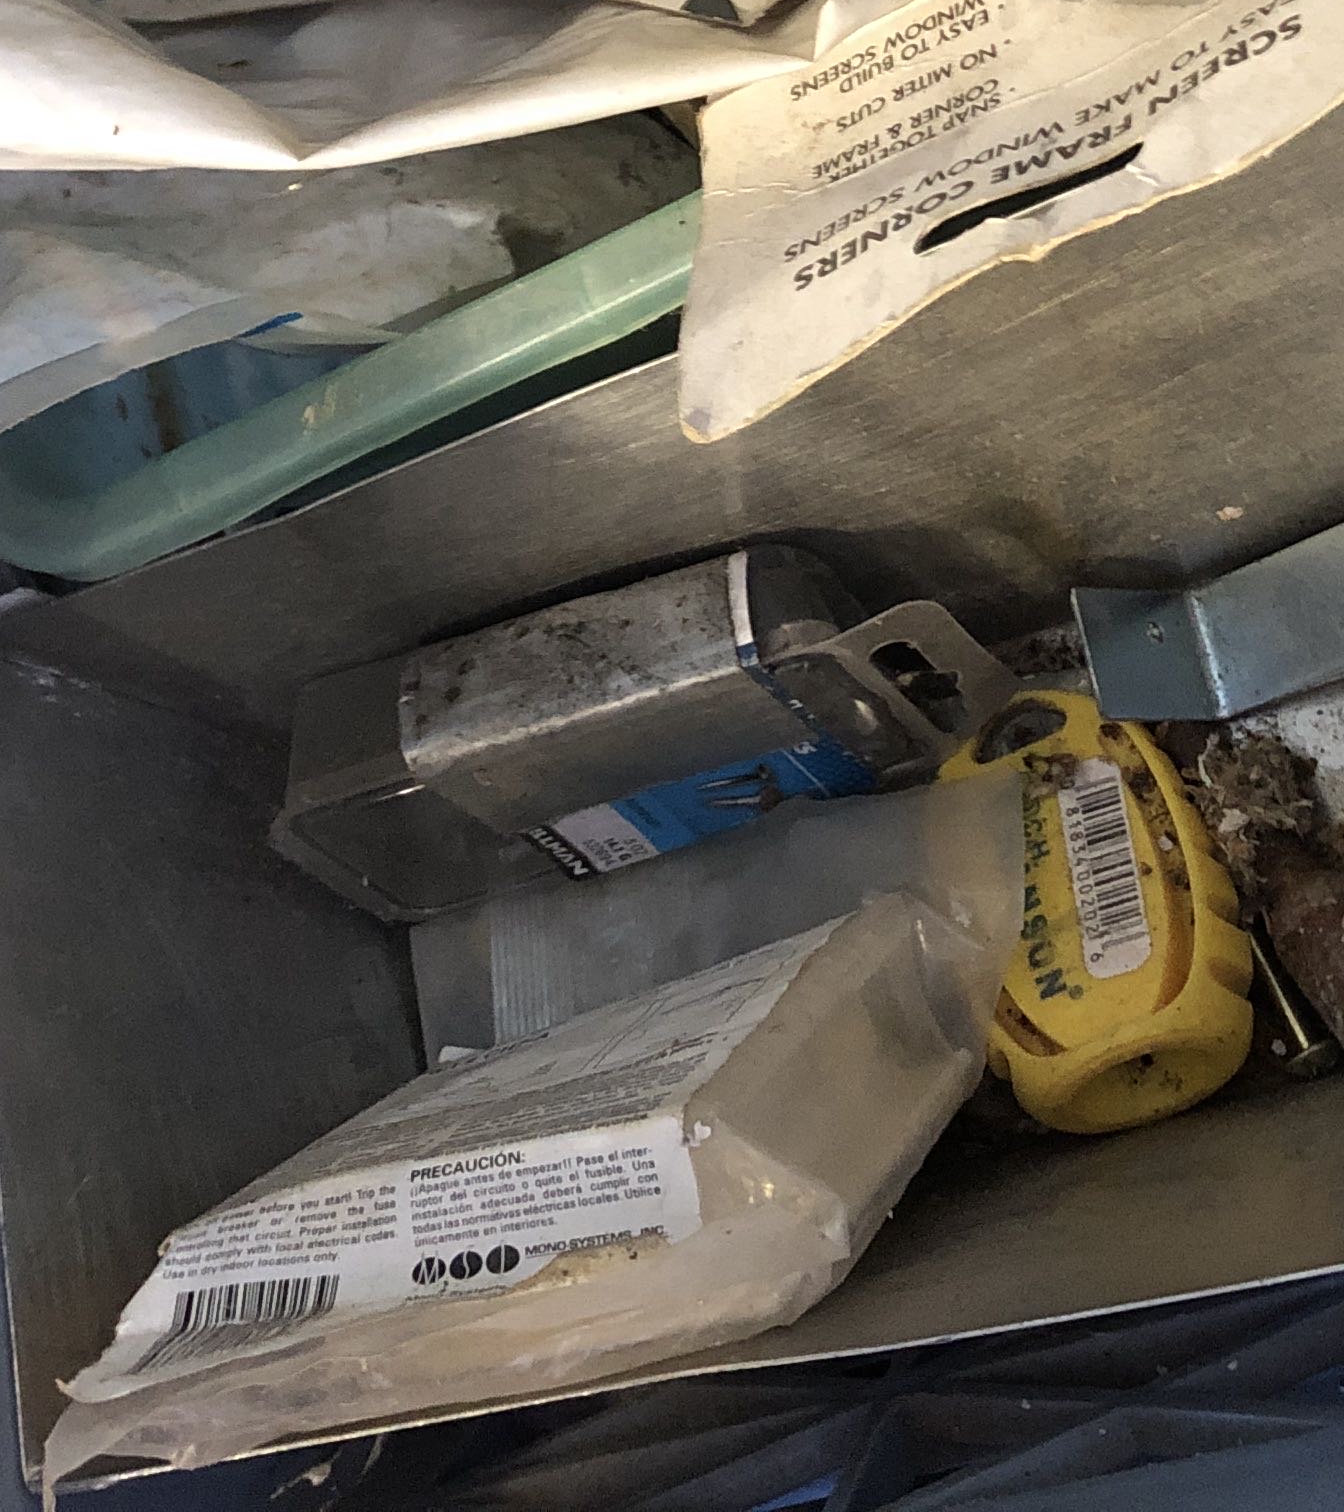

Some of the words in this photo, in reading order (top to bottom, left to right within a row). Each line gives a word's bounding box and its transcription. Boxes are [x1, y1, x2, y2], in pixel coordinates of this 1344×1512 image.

[935, 8, 990, 46] EASY
[900, 37, 931, 61] TO
[959, 43, 998, 71] NO
[1146, 14, 1304, 116] SCREEN
[1169, 40, 1210, 72] TO
[790, 45, 877, 102] SCREENS
[838, 53, 895, 95] BUILD
[892, 62, 953, 102] MITER
[836, 95, 887, 133] CUTS
[908, 78, 999, 130] CORNER
[942, 92, 1002, 132] SNAP
[1074, 68, 1162, 125] MAKE
[885, 121, 903, 139] &
[990, 112, 1134, 185] FRAME
[811, 133, 880, 179] FRAME
[913, 120, 1066, 192] WINDOW
[783, 188, 905, 263] SCREENS
[793, 181, 975, 290] CORNERS
[410, 1150, 526, 1182] PRECAUCIÓN:
[410, 1194, 444, 1210] ruptor
[449, 1189, 468, 1202] del
[473, 1182, 515, 1199] circuito
[534, 1174, 564, 1191] quite
[568, 1170, 580, 1182] el
[584, 1163, 627, 1180] fusible.
[631, 1159, 656, 1172] Una
[463, 1172, 495, 1186] antes
[498, 1168, 513, 1180] de
[607, 1149, 619, 1161] el
[621, 1146, 653, 1160] inter-
[269, 1217, 282, 1226] or
[295, 1210, 337, 1223] remove
[347, 1205, 364, 1216] the
[374, 1199, 396, 1211] fuse
[300, 1199, 319, 1211] you
[356, 1188, 375, 1201] Trip
[379, 1185, 396, 1197] the
[411, 1202, 474, 1222] instalación
[479, 1191, 536, 1211] adecuada
[542, 1183, 583, 1201] deberá
[589, 1176, 630, 1193] cumplir
[636, 1172, 659, 1184] con
[412, 1219, 443, 1235] todas
[443, 1217, 460, 1230] las
[460, 1207, 522, 1226] normativas
[522, 1198, 577, 1217] eléctricas
[623, 1185, 661, 1201] Utilice
[247, 1243, 273, 1254] with
[275, 1239, 304, 1252] local
[299, 1224, 337, 1238] Proper
[413, 1227, 481, 1248] únicamente
[483, 1226, 498, 1236] en
[500, 1216, 558, 1233] interiores.
[162, 1269, 185, 1280] Use
[188, 1267, 199, 1277] in
[201, 1264, 218, 1276] dry
[220, 1259, 254, 1272] indoor
[258, 1254, 311, 1267] locations
[313, 1251, 341, 1264] only.
